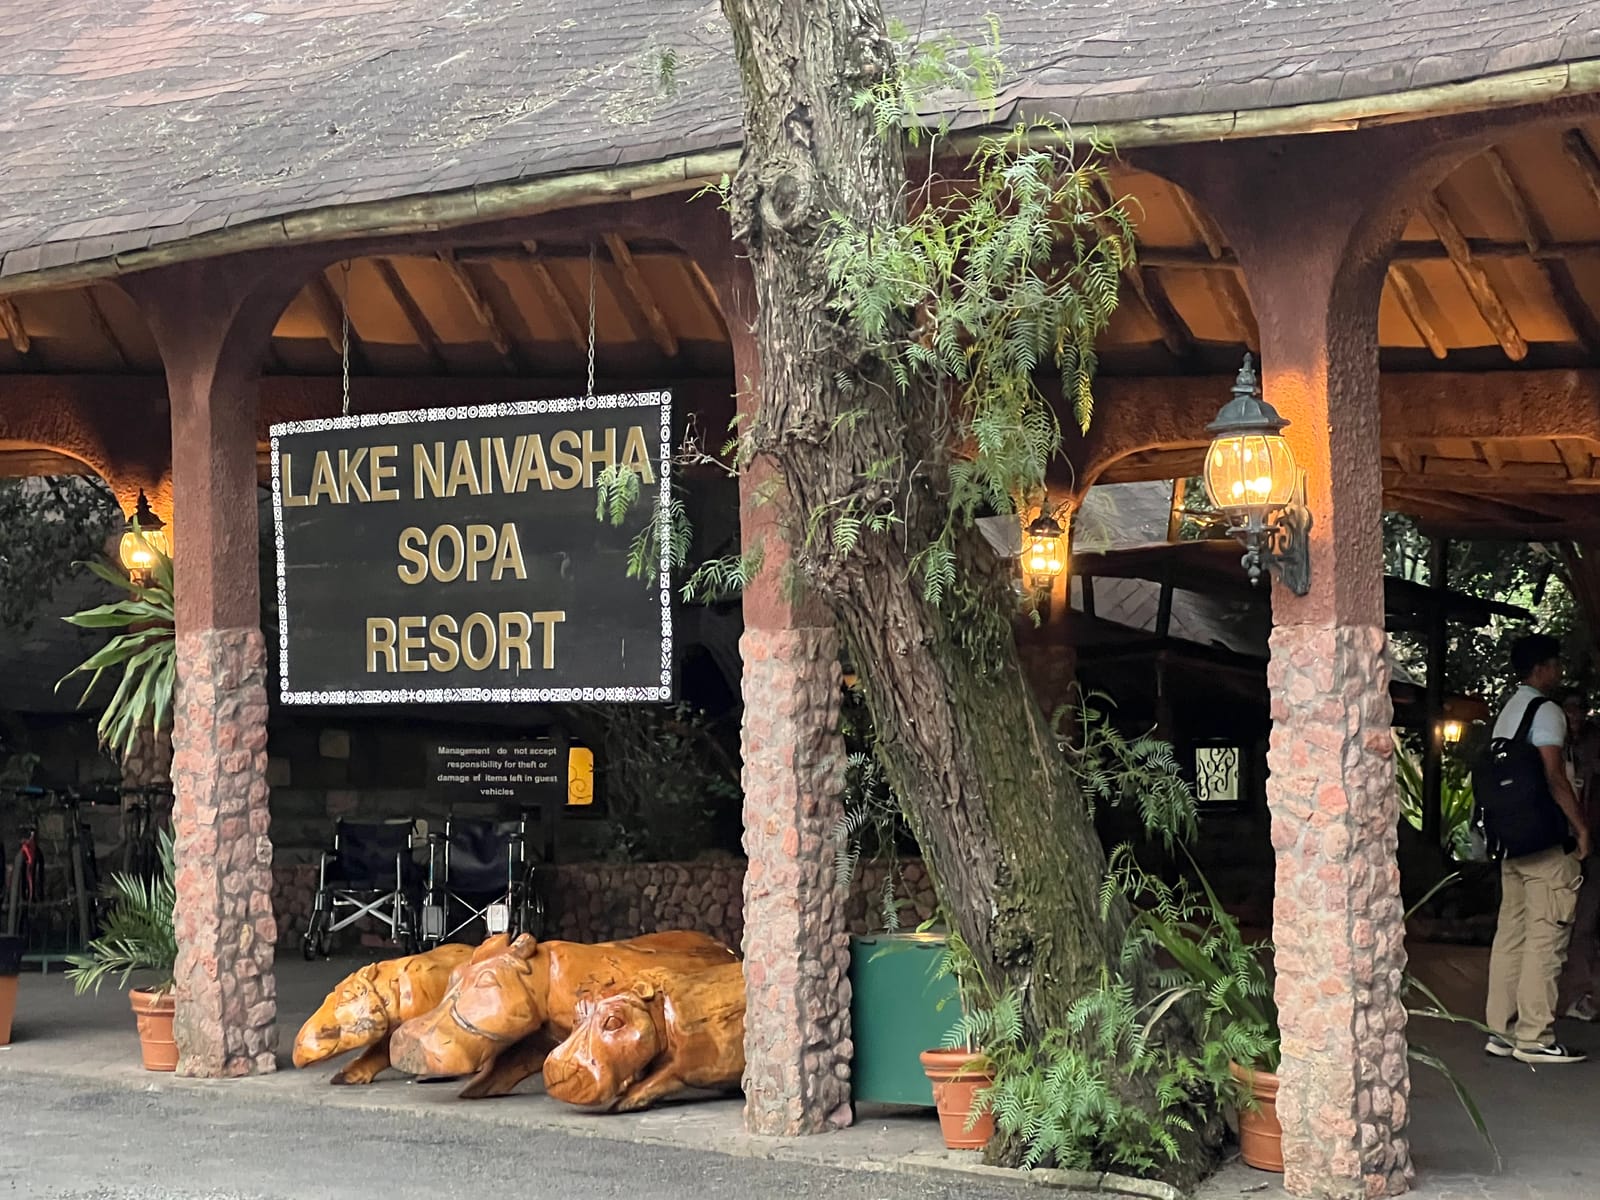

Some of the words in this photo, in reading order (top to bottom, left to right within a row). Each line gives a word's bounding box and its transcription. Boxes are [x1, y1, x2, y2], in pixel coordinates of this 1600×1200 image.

[281, 445, 399, 507] LAKE
[413, 426, 655, 499] NAIVASHA
[397, 523, 527, 584] SOPA
[366, 611, 565, 673] RESORT
[438, 746, 490, 756] Management
[496, 747, 508, 755] do
[513, 747, 528, 755] not
[529, 747, 557, 757] accept
[447, 760, 502, 770] responsibility
[504, 760, 516, 769] for
[517, 760, 537, 769] theft
[437, 774, 470, 783] damage
[485, 774, 508, 782] items
[509, 774, 523, 782] left
[524, 774, 533, 782] in
[534, 775, 558, 784] guest
[480, 788, 514, 796] vehicles
